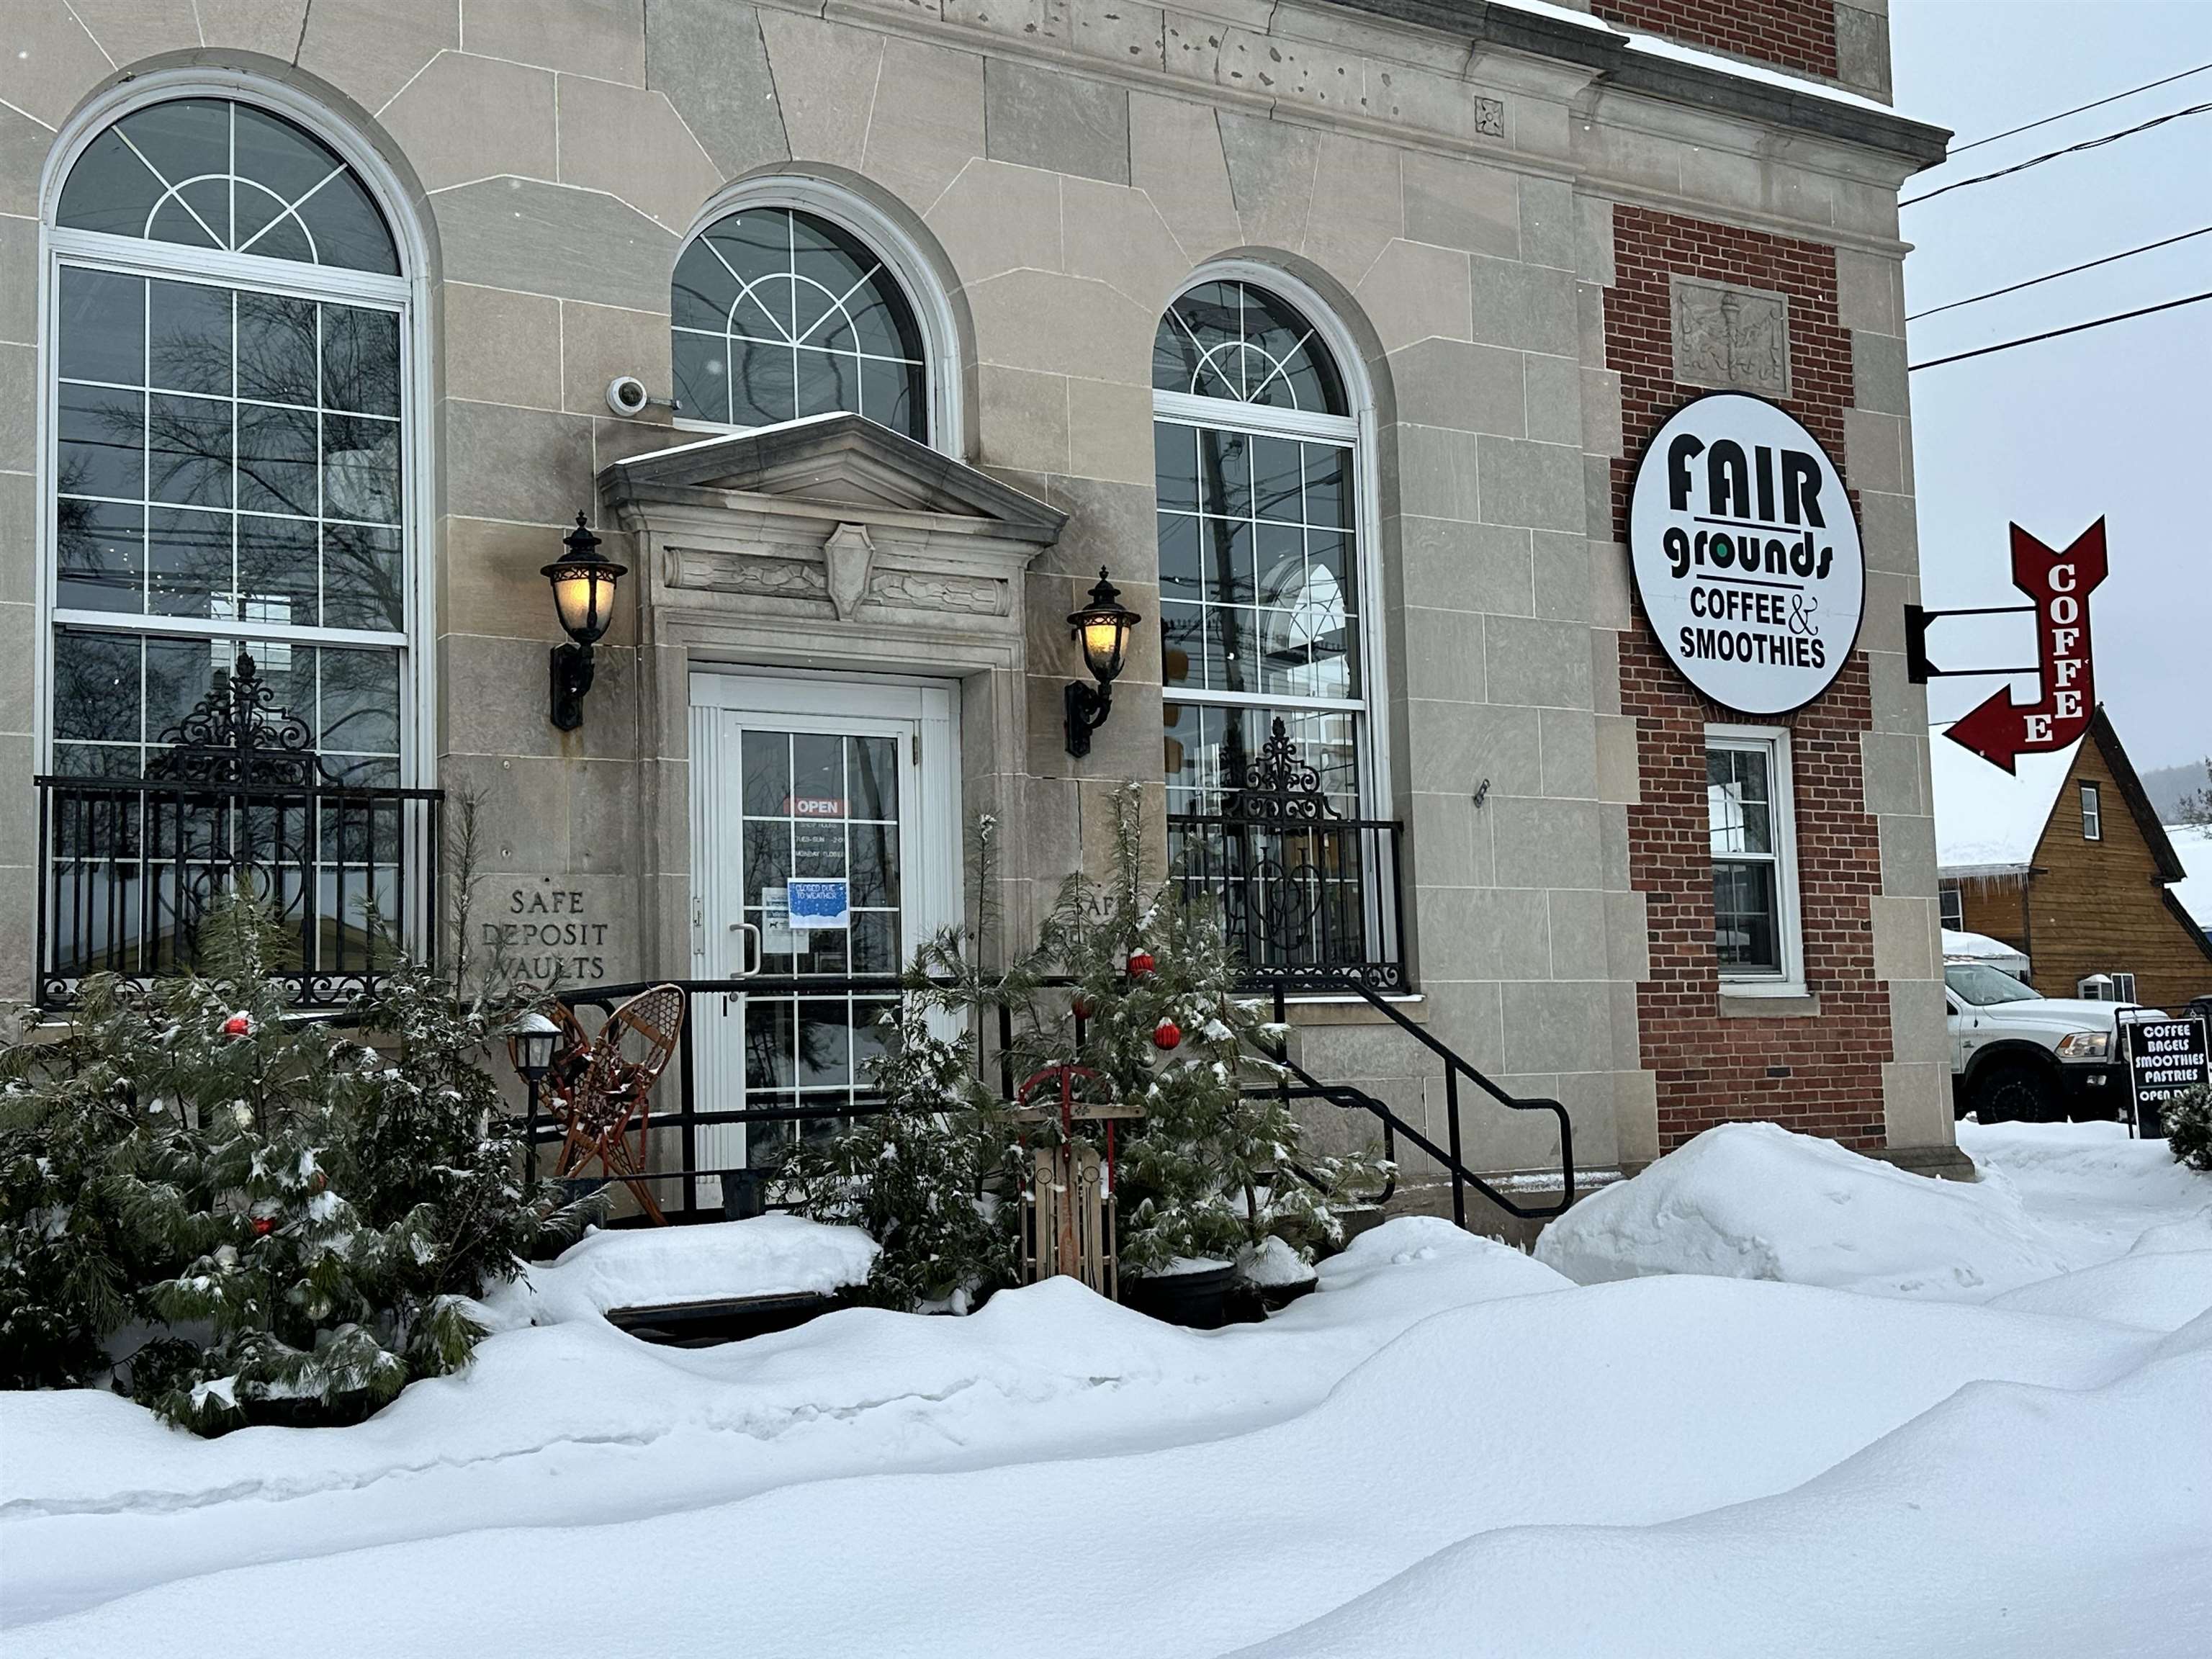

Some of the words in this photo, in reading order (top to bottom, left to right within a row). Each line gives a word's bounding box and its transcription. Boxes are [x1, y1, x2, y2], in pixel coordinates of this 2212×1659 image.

[1667, 433, 1826, 529] FAIR
[1663, 526, 1833, 579] grounds
[1690, 586, 1786, 625] COFFEE
[1789, 594, 1819, 636] &
[1680, 626, 1826, 669] SMOOTHIES
[2023, 564, 2083, 742] COFFEE
[797, 801, 838, 813] OPEN
[510, 889, 584, 914] SAFE
[482, 923, 608, 946] DEPOSIT
[494, 956, 604, 979] VAULTS
[2143, 1025, 2190, 1038] COFFEE
[2147, 1039, 2190, 1052] BAGELS
[2135, 1053, 2204, 1068] SMOOTHIES
[2145, 1069, 2198, 1083] PASTRIES
[2139, 1089, 2170, 1101] OPEN
